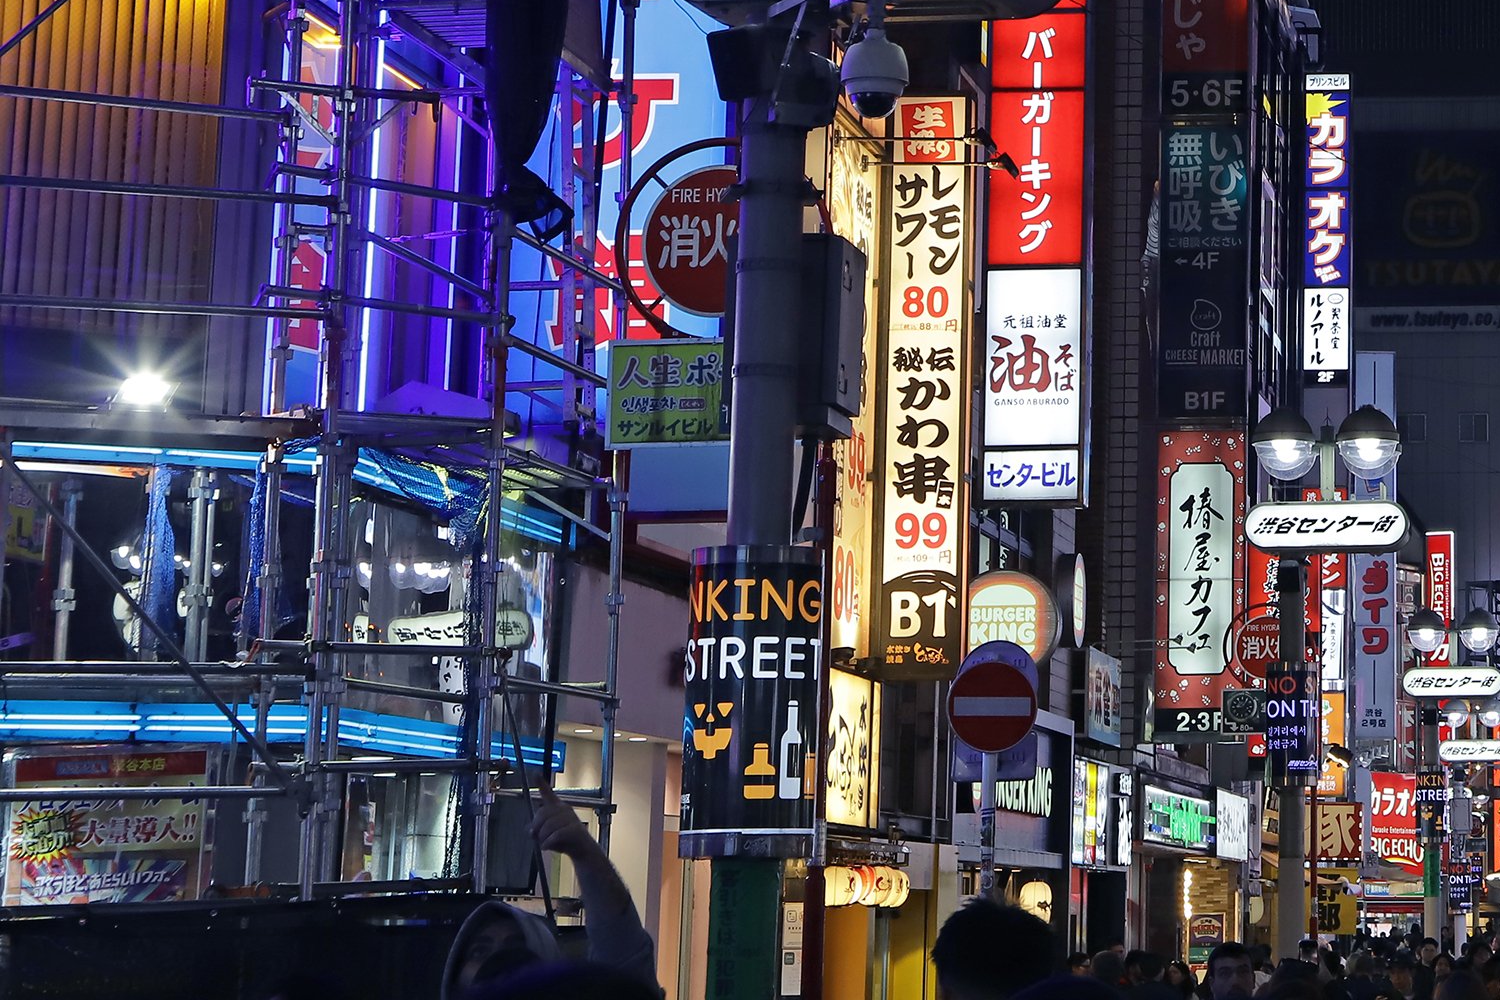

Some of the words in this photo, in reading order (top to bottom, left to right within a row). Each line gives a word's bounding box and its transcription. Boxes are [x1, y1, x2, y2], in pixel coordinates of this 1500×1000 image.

[1019, 28, 1055, 254] バーガーキング
[1169, 131, 1203, 233] 無呼吸
[1209, 131, 1245, 231] いびき
[1308, 111, 1347, 266] カラオケ
[672, 188, 700, 203] FIRE
[895, 173, 928, 279] サワー
[929, 165, 961, 276] レモン
[659, 213, 740, 268] 消火
[1191, 251, 1220, 269] 4F
[902, 286, 949, 318] 80
[1003, 314, 1068, 330] 元祖油堂
[1309, 293, 1325, 365] ルノアール
[1191, 331, 1221, 348] Craft
[892, 346, 956, 372] 秘伝
[990, 333, 1052, 395] 油
[1053, 343, 1076, 393] そば
[1166, 350, 1198, 361] CHEESE
[1200, 349, 1244, 366] MARKET
[617, 354, 724, 389] 人生ポ
[1317, 371, 1335, 383] 2F
[1184, 391, 1225, 409] B1F
[617, 418, 713, 438] サンルイビル
[893, 377, 951, 505] かわ串
[986, 463, 1076, 489] センタービル
[895, 512, 948, 549] 99
[1254, 515, 1399, 534] 渋谷センター街
[1179, 486, 1225, 651] 椿屋カフェ
[1430, 553, 1445, 583] BIG
[890, 589, 948, 638] B1
[970, 606, 1036, 622] BURGER
[970, 623, 1036, 643] KING
[1261, 624, 1280, 632] HYDRA
[1267, 676, 1297, 695] NO
[1407, 676, 1498, 689] 渋谷センター街
[1267, 700, 1295, 718] ON
[1365, 708, 1383, 717] 渋谷
[1361, 719, 1386, 728] 2号店
[1417, 775, 1445, 786] NKIN
